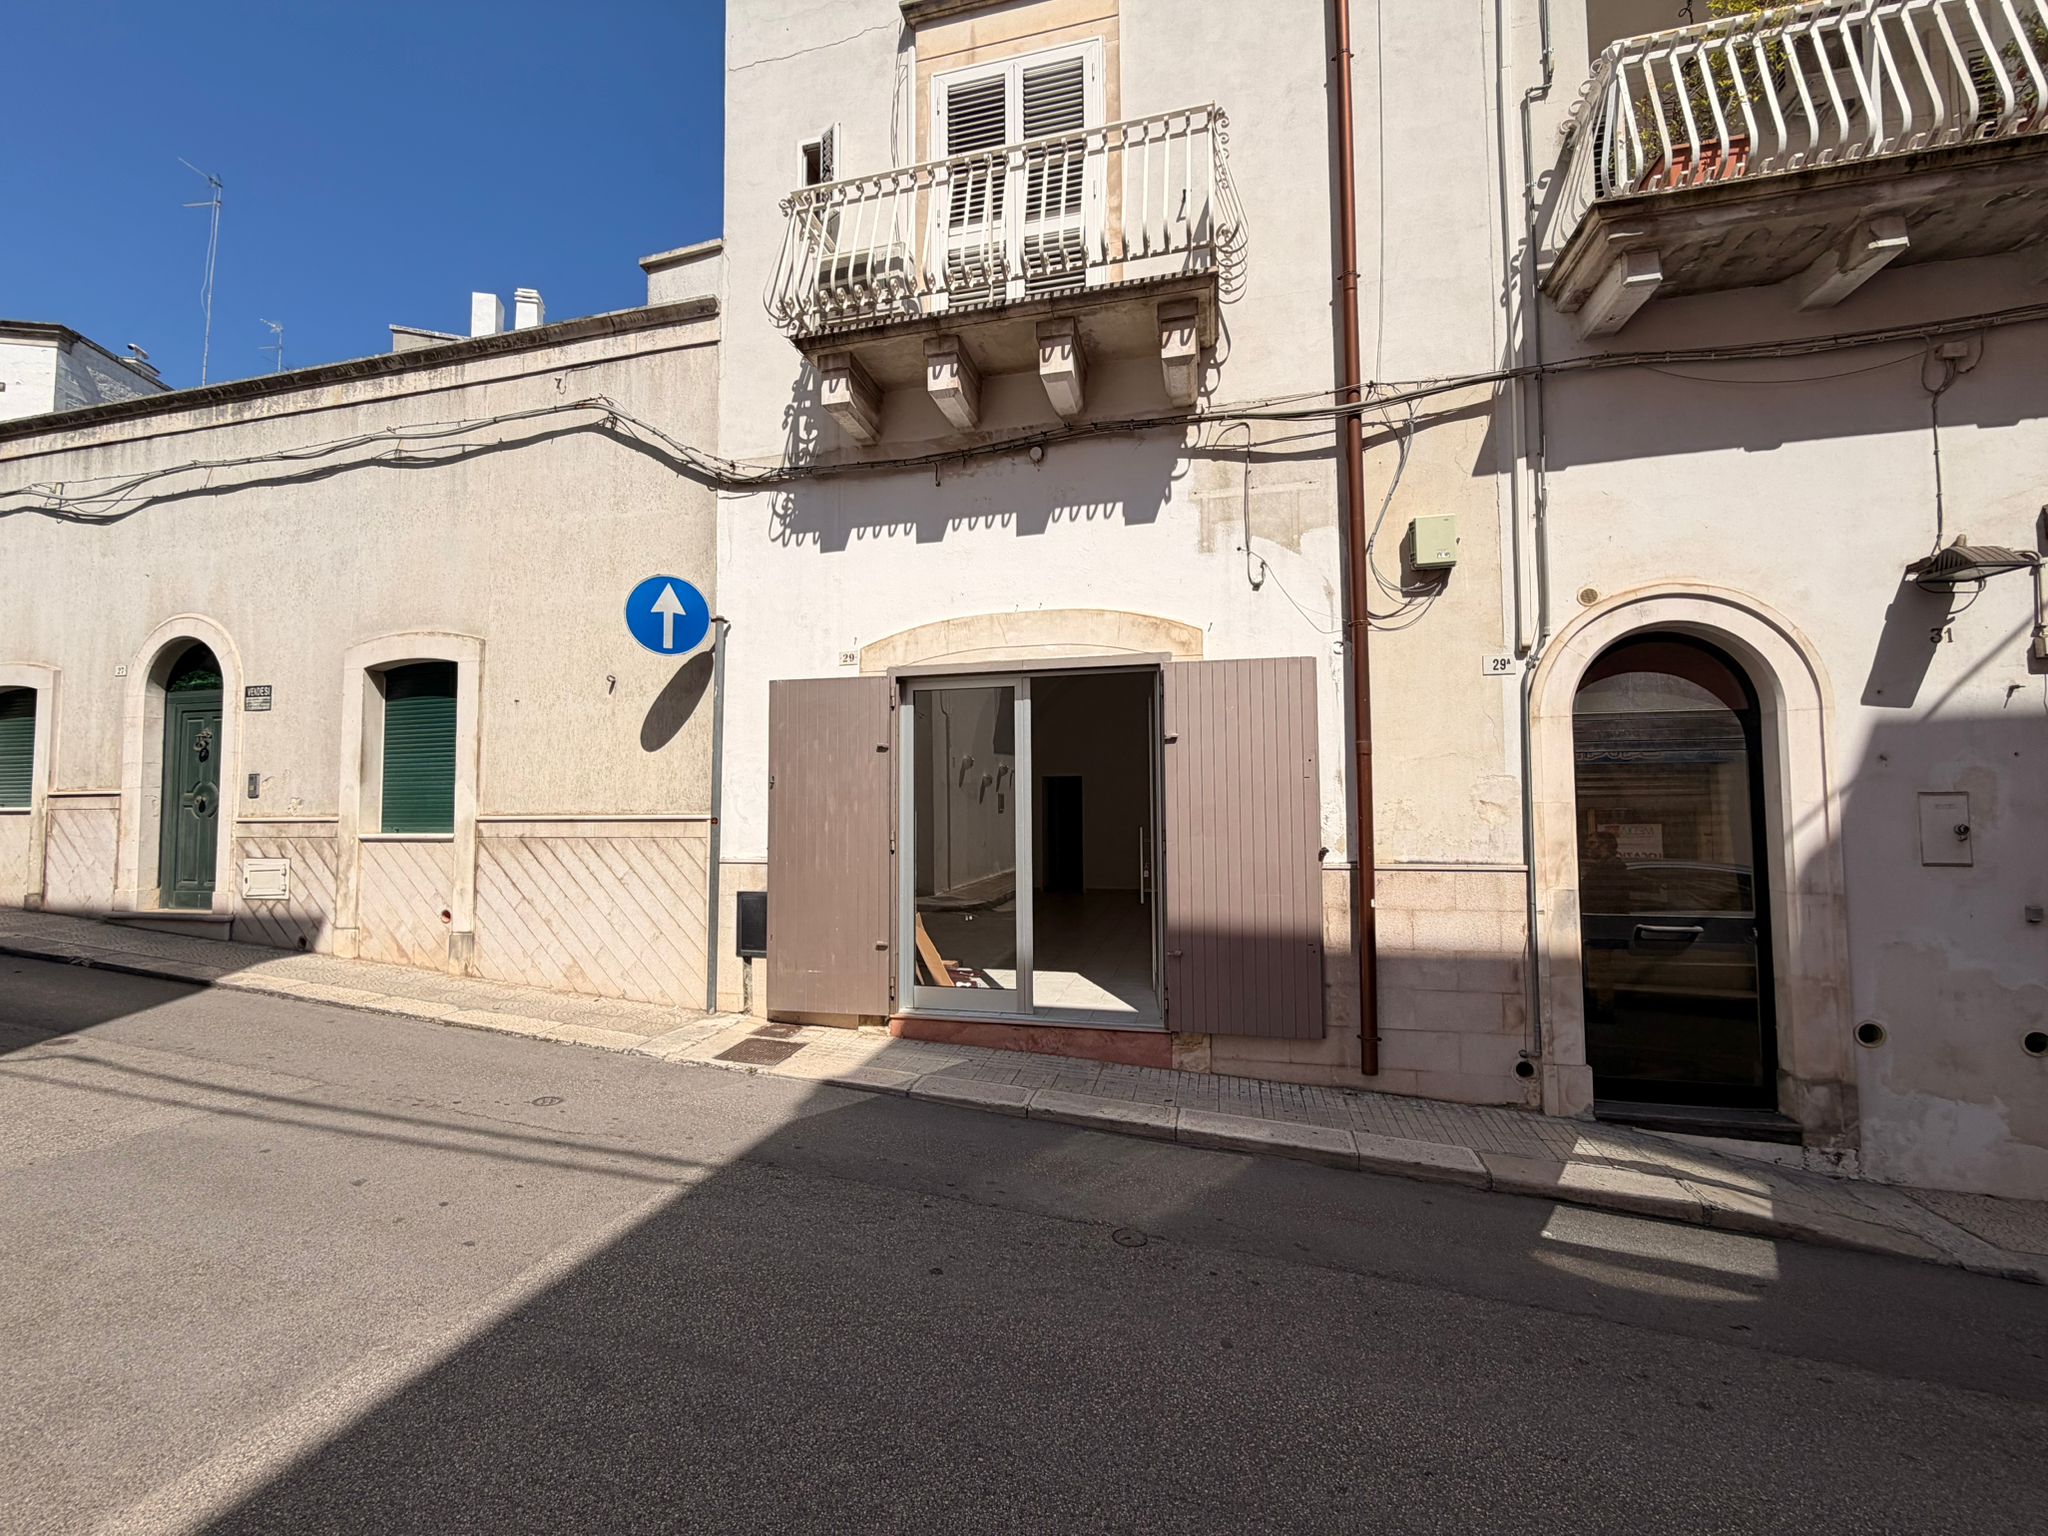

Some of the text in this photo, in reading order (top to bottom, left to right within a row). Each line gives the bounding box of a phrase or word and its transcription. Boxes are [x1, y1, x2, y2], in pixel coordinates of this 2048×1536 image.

[1930, 628, 1954, 643] 31
[842, 653, 855, 663] 29
[117, 667, 125, 675] 27
[247, 686, 271, 697] VENDESI
